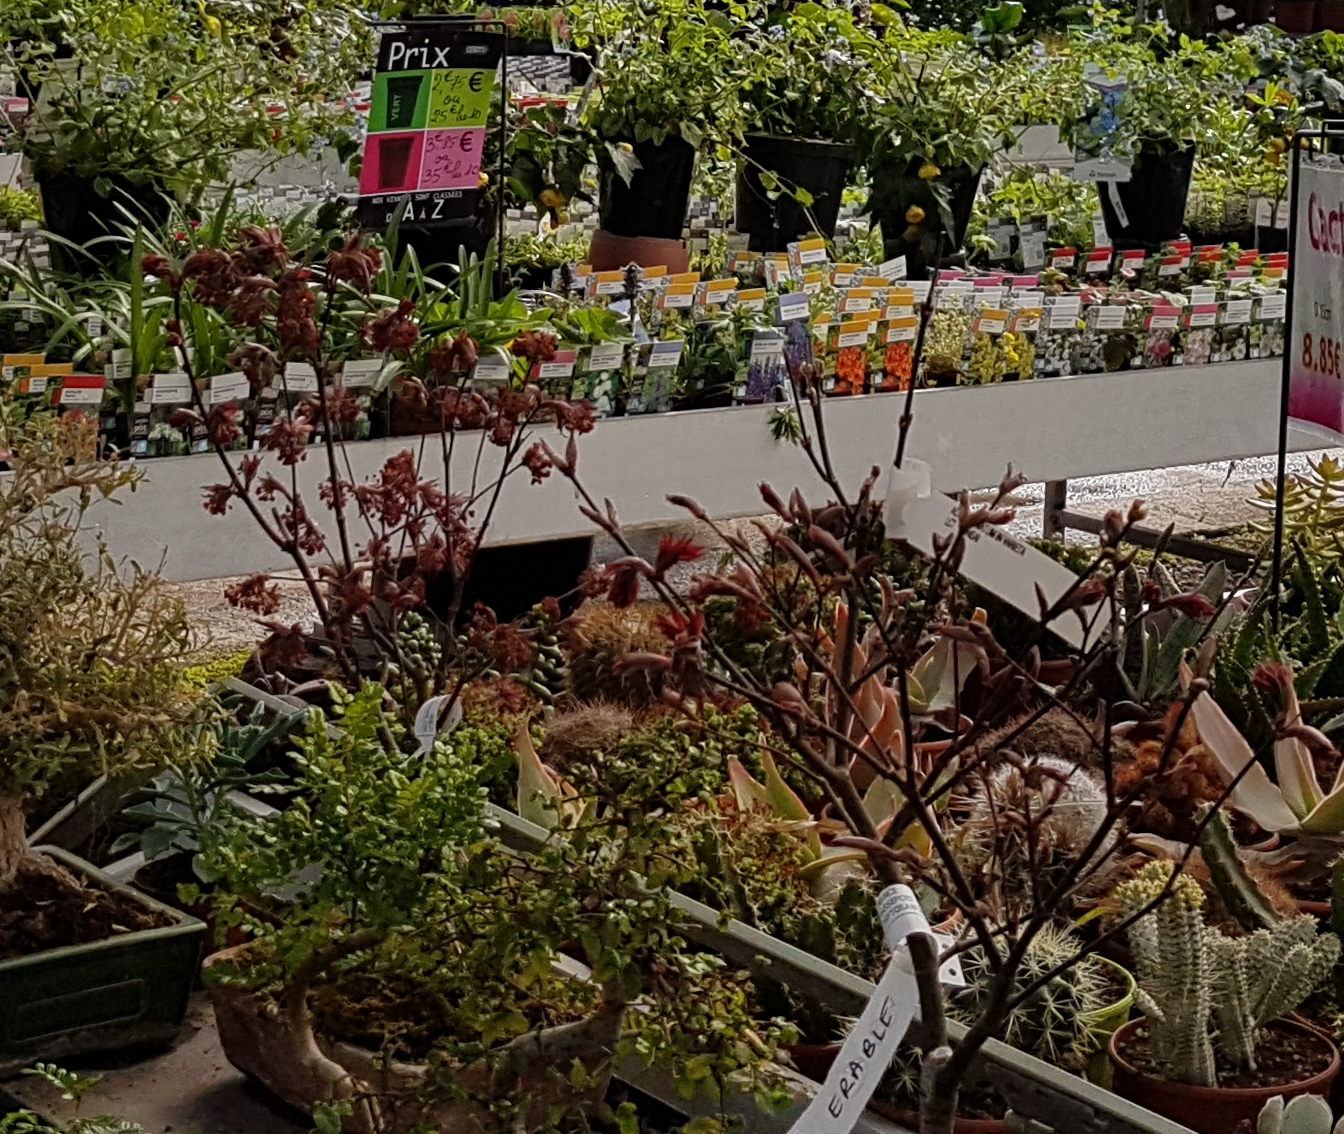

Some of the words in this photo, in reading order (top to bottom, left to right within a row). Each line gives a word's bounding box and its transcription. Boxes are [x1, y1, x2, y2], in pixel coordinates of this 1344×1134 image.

[388, 38, 451, 70] Prix
[402, 201, 415, 221] A
[431, 199, 445, 219] Z
[1301, 333, 1341, 380] 8.85€
[828, 996, 895, 1119] ERABLE
